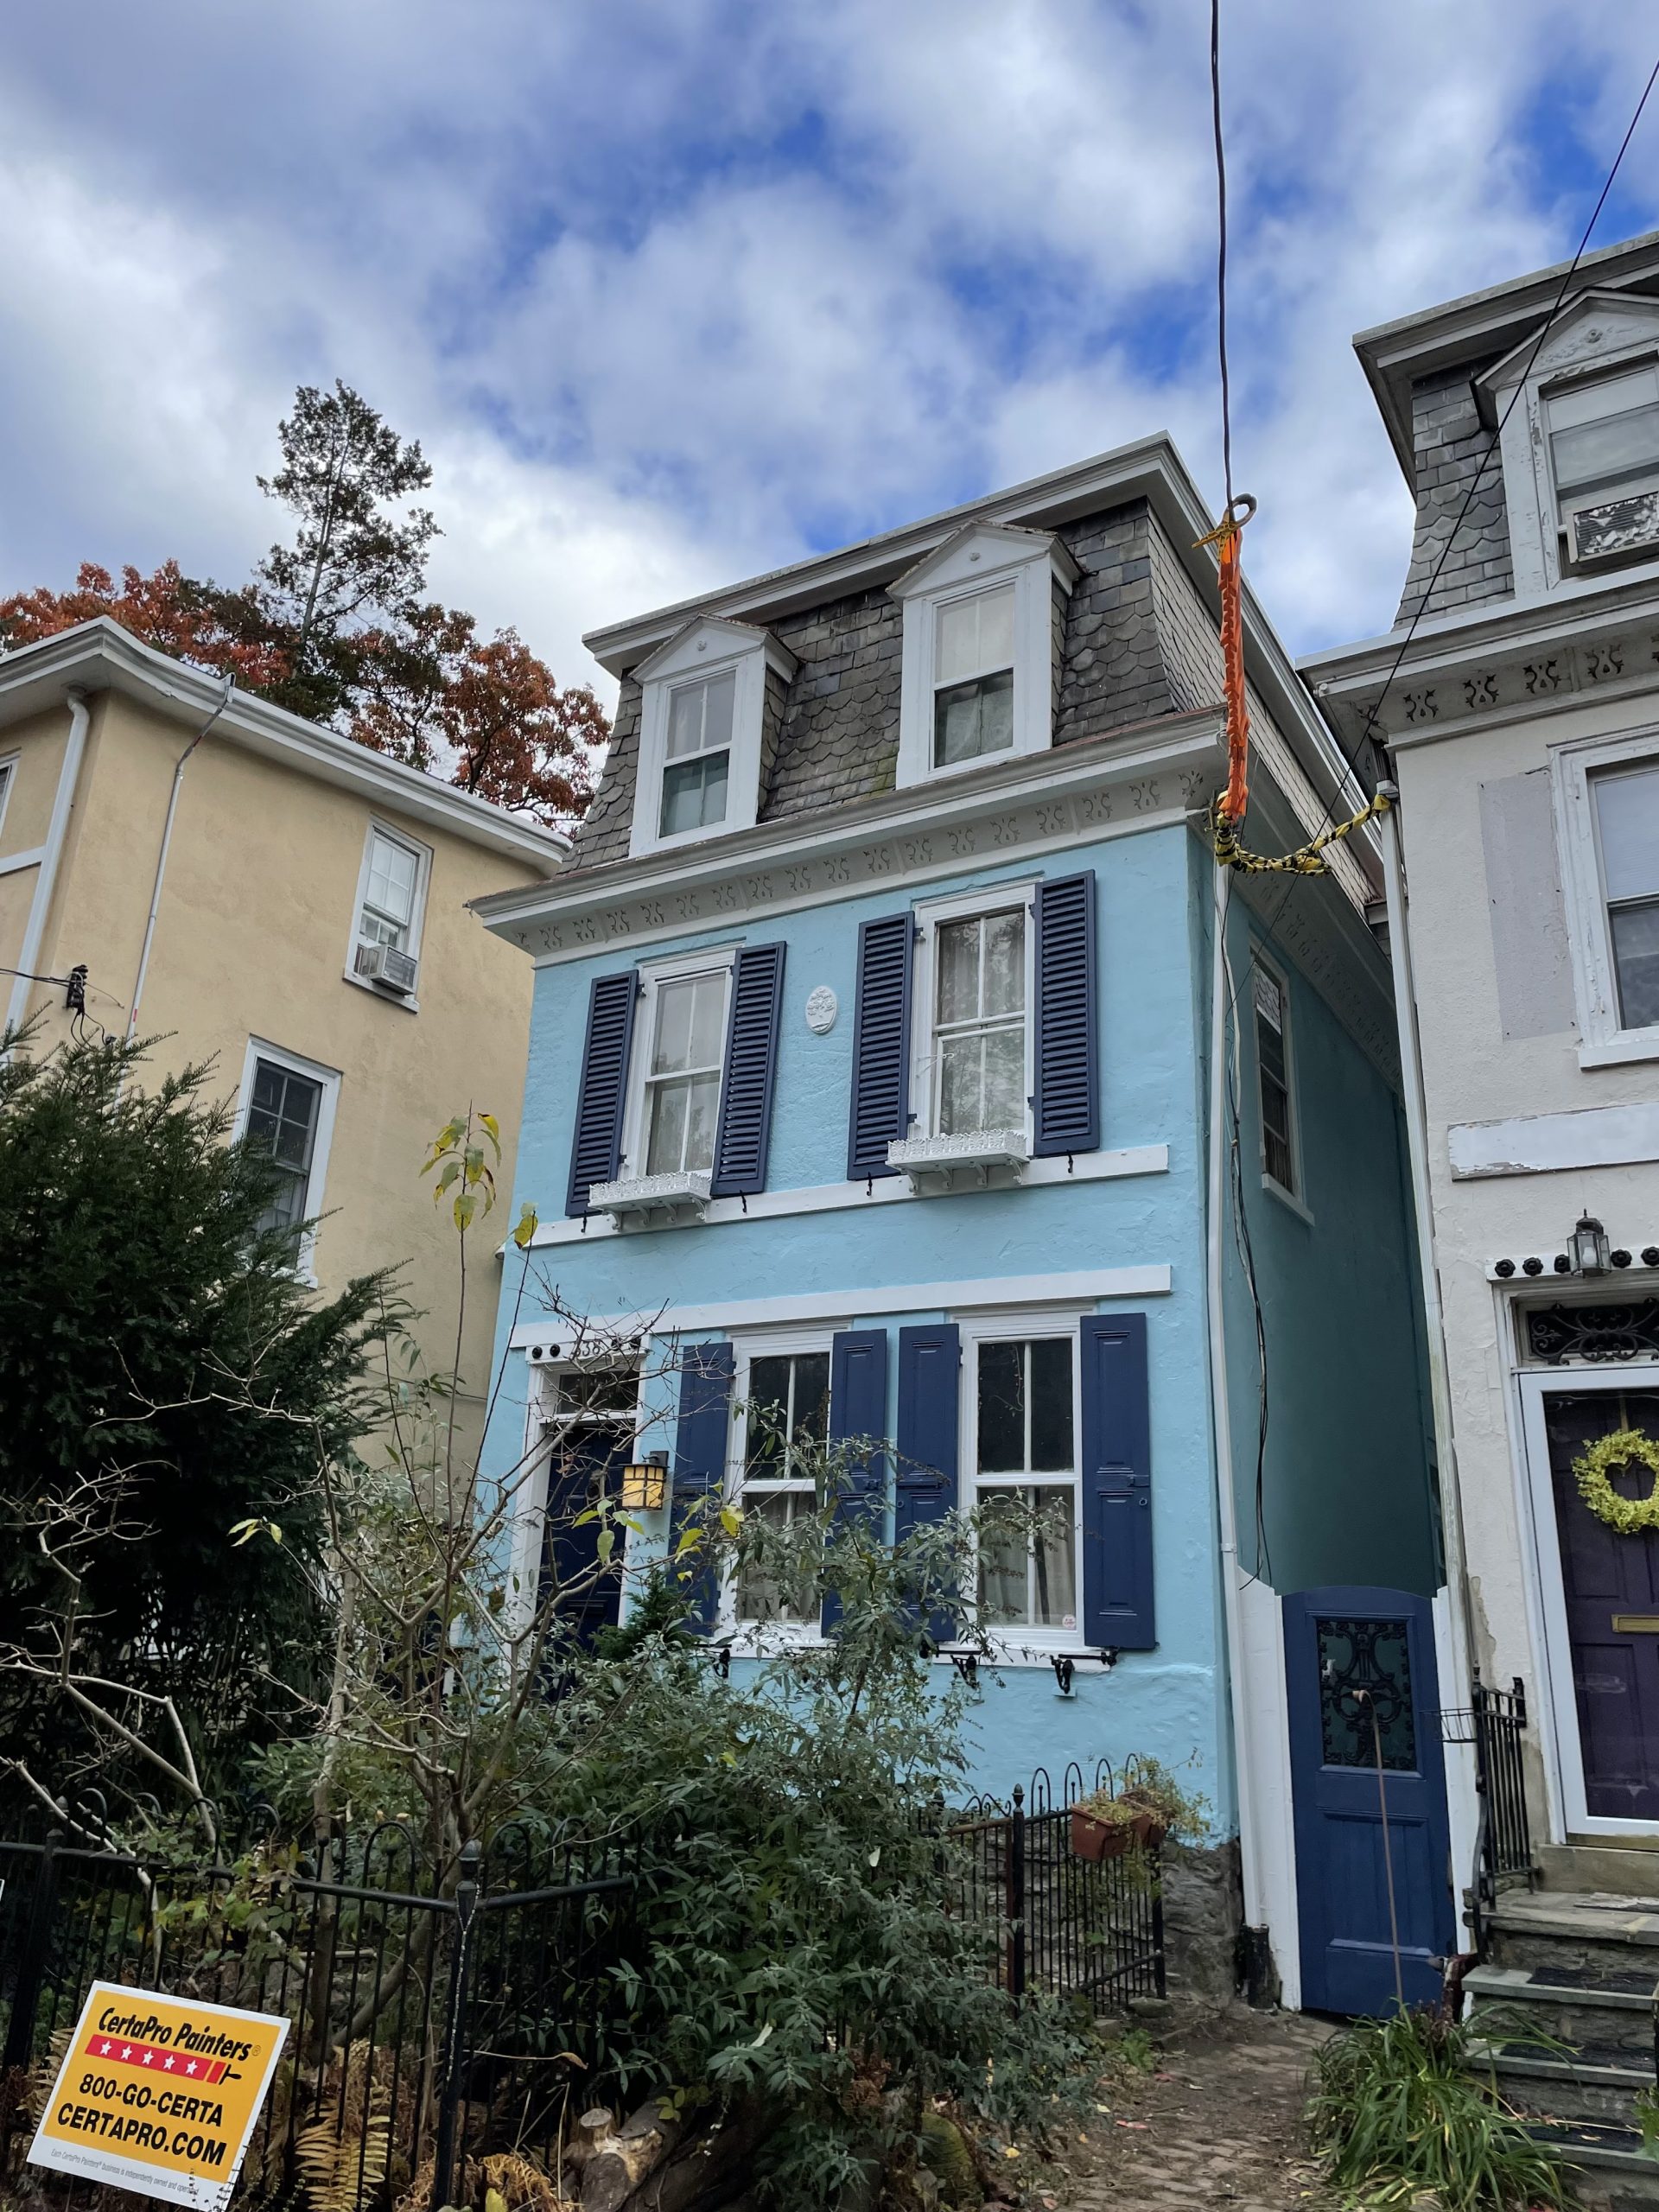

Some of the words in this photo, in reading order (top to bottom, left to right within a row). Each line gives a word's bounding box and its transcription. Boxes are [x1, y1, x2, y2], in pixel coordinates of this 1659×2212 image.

[99, 2007, 172, 2044] CertaPro
[79, 2073, 223, 2127] 800-GO-CERTA
[57, 2102, 227, 2166] CERTAPRO.COM
